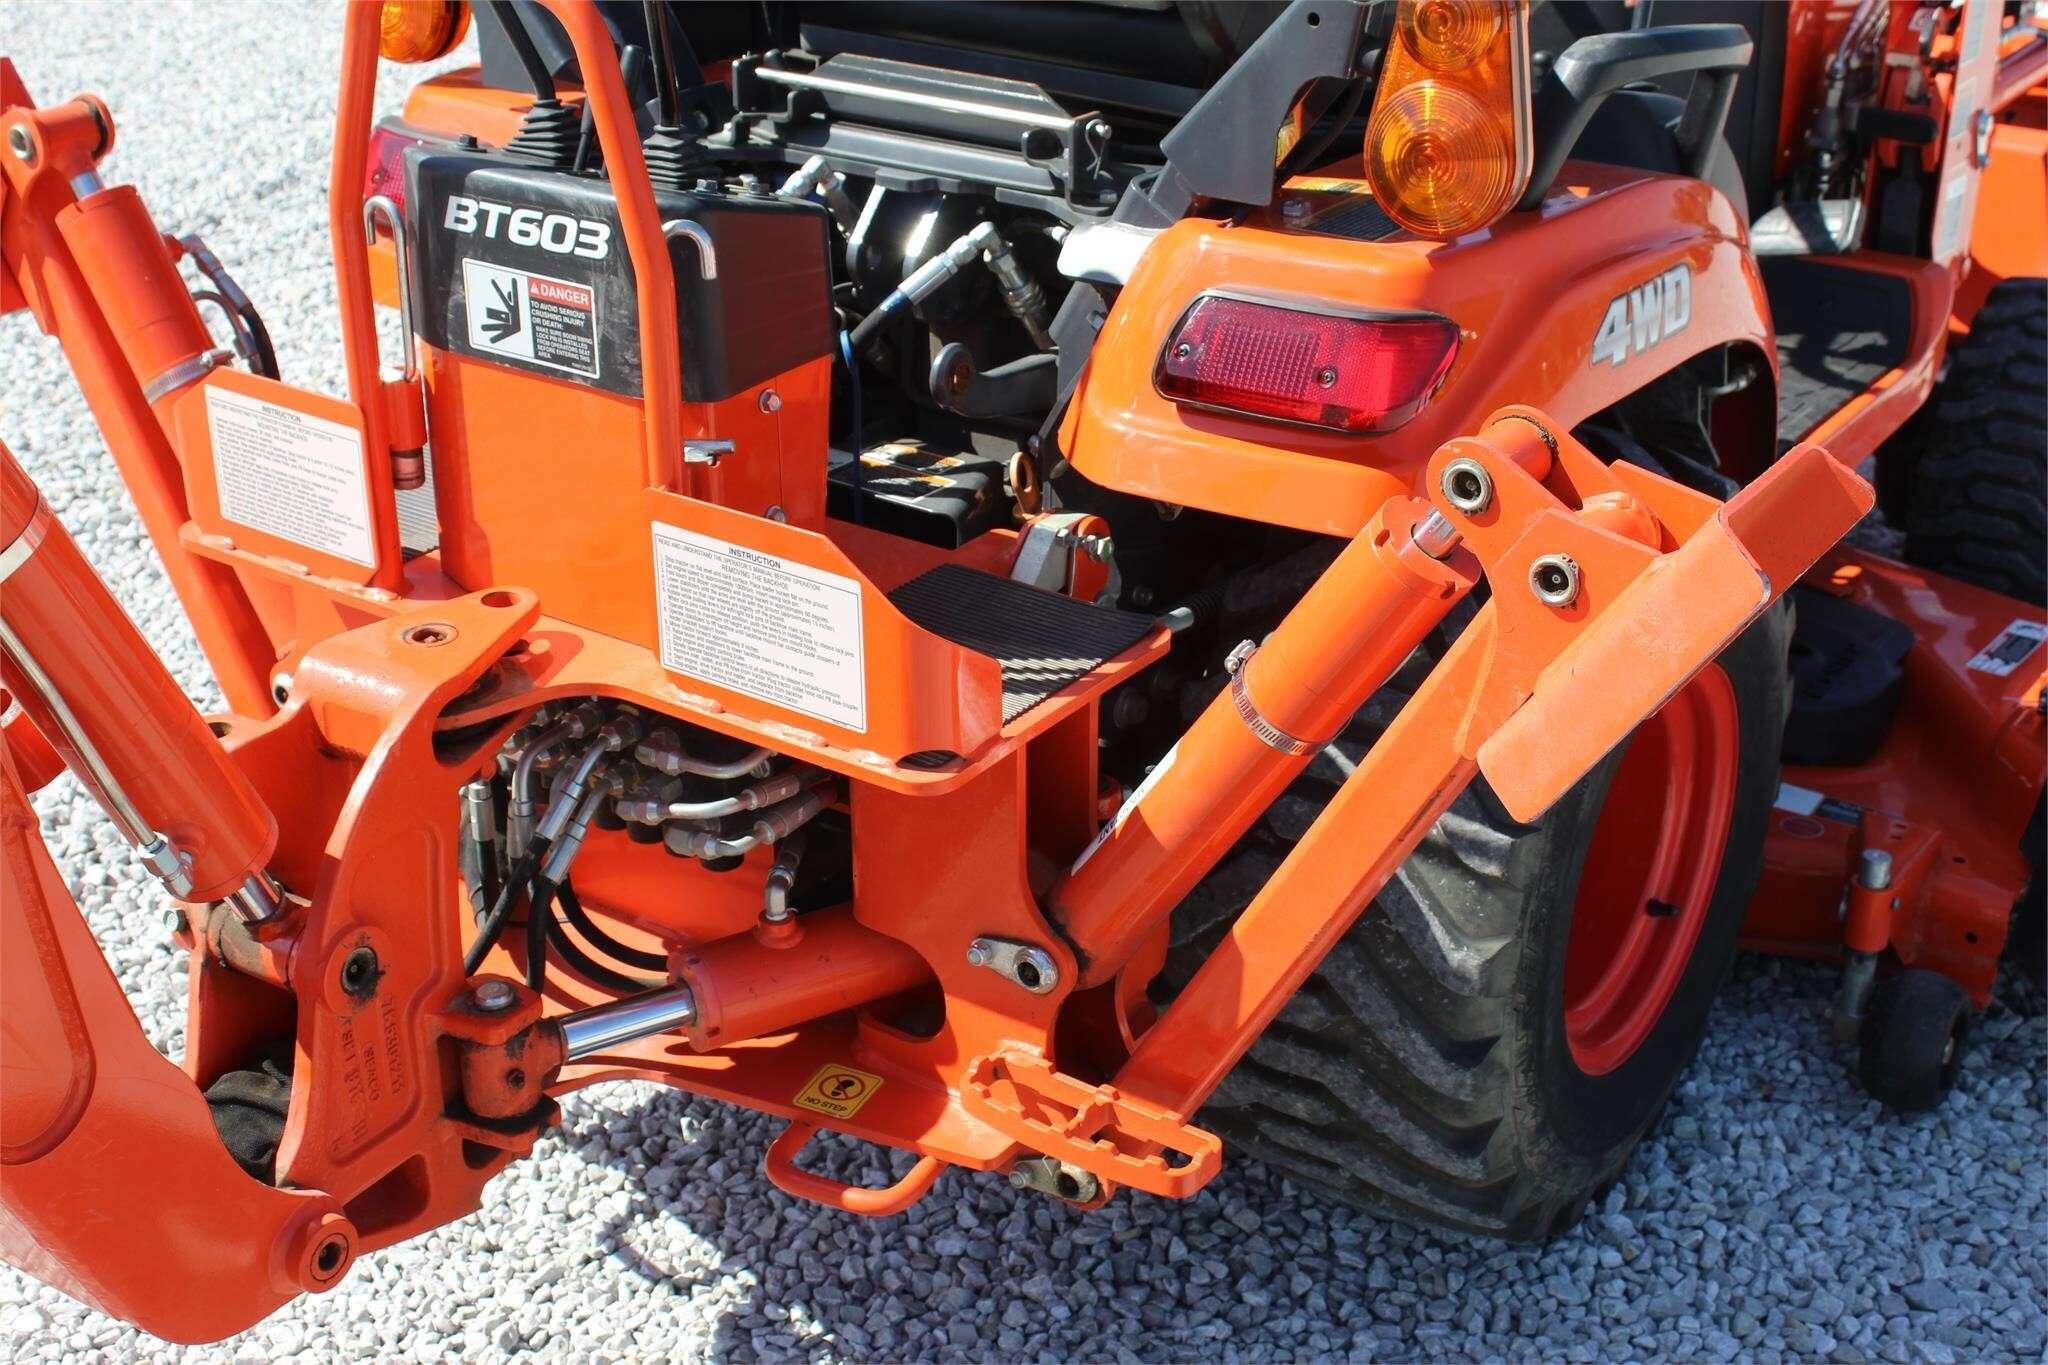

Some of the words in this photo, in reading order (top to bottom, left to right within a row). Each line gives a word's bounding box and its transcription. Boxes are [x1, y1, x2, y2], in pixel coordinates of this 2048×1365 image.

[444, 195, 611, 260] BT603
[540, 284, 588, 304] DANGER
[531, 309, 562, 321] CRUSHING
[562, 316, 584, 327] INJURY
[540, 302, 558, 312] AVOID
[559, 307, 585, 320] SERIOUS
[1592, 263, 1690, 366] 4WD
[542, 319, 564, 330] DEATH:
[728, 546, 780, 568] INSTRUCTION
[804, 1097, 820, 1105] NO
[821, 1101, 847, 1112] STEP
